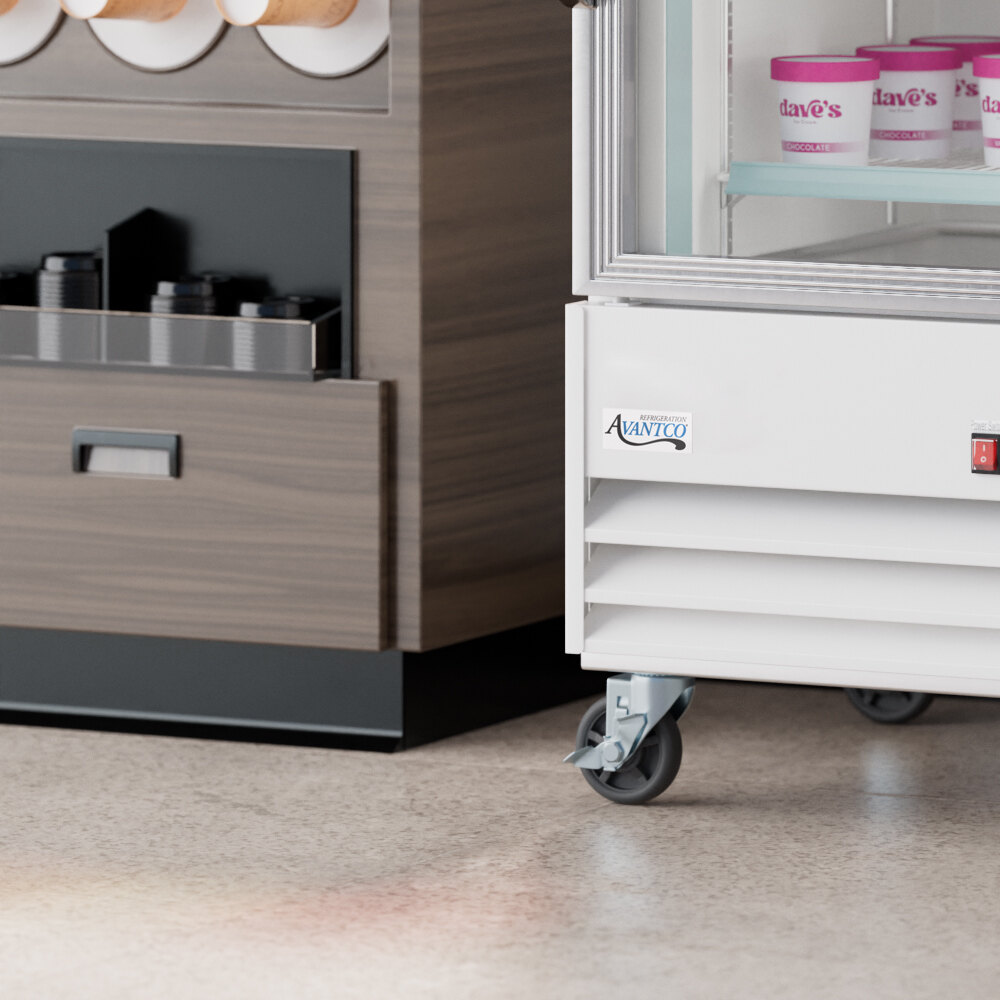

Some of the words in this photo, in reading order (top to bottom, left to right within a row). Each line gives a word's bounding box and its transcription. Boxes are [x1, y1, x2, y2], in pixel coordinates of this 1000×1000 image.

[872, 88, 938, 107] dave's
[779, 98, 843, 119] dave's
[878, 131, 927, 140] CHOCOLATE
[786, 142, 831, 152] CHOCOLATE
[639, 414, 687, 423] REFRIGERATION
[604, 413, 688, 450] AVANTCO
